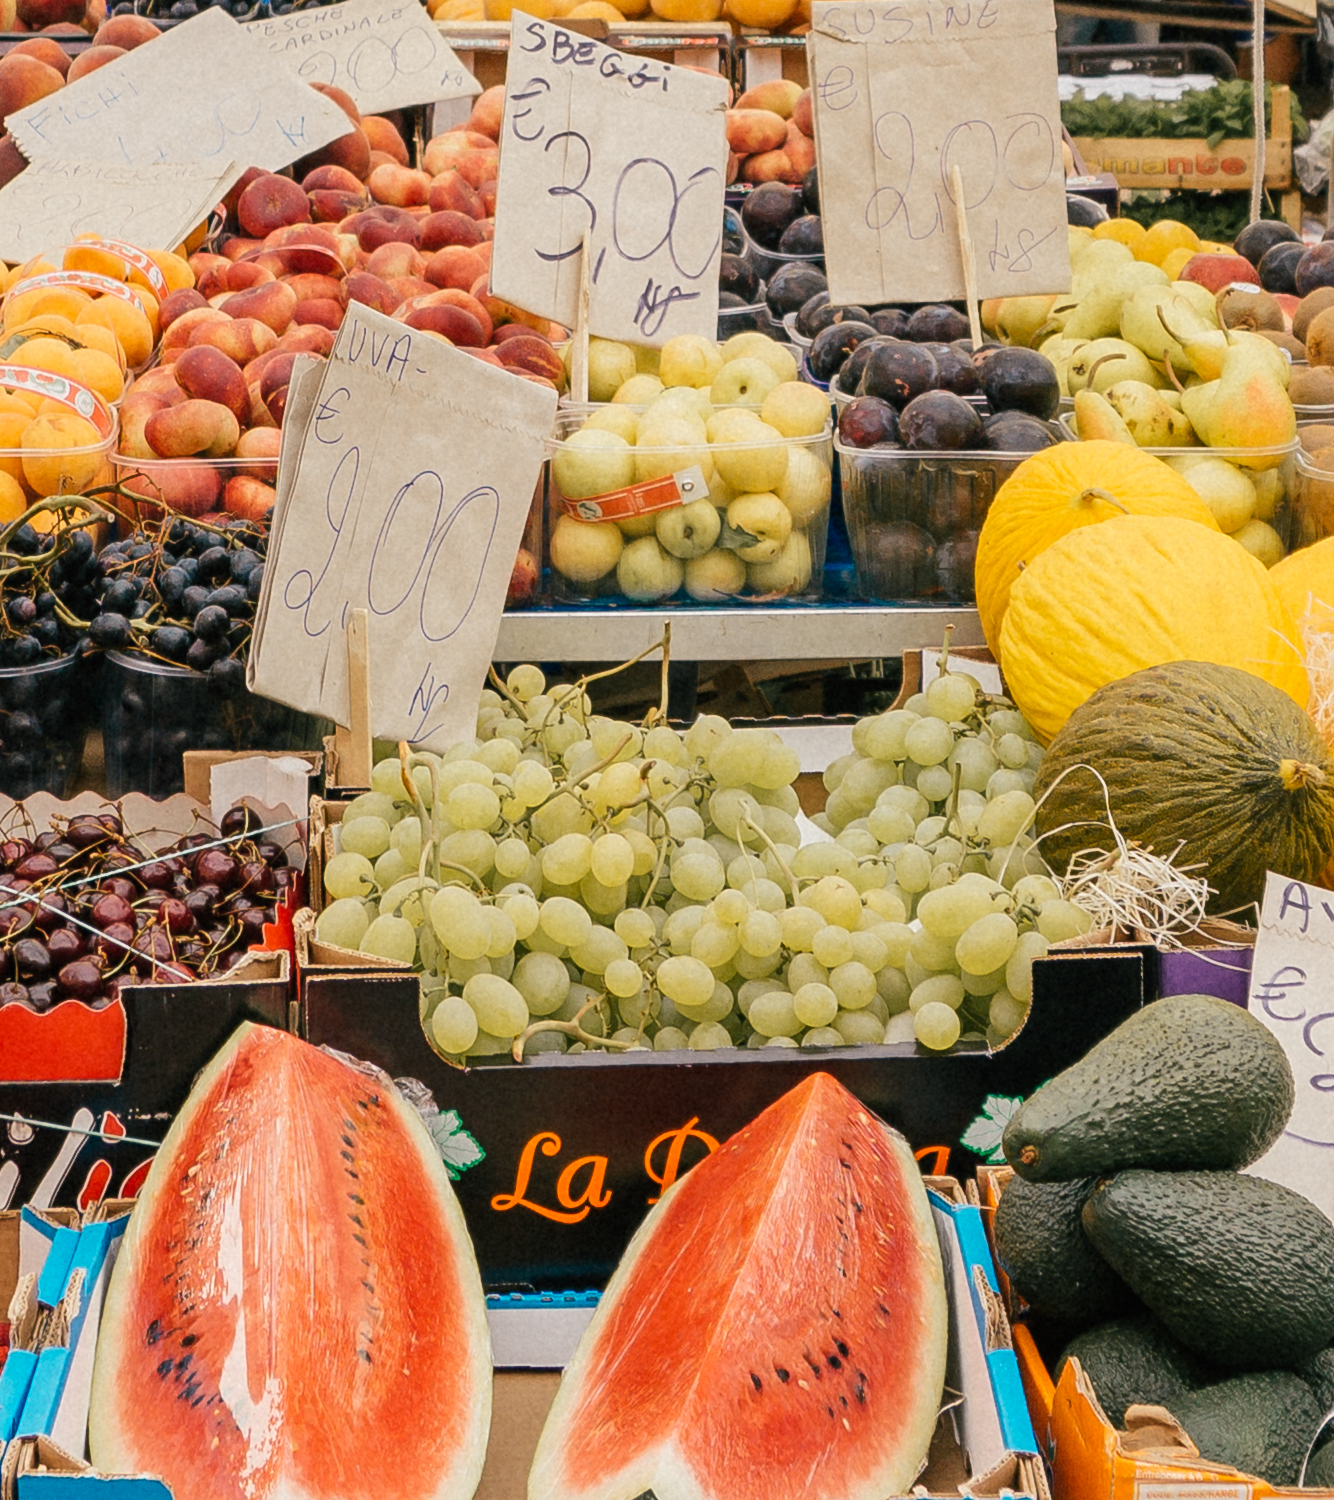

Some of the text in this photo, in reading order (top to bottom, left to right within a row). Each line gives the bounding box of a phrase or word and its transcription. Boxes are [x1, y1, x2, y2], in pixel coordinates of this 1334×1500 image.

[817, 67, 857, 108] €
[534, 131, 723, 284] 3,00
[314, 385, 351, 445] €
[284, 447, 500, 642] 2,00
[1255, 963, 1309, 1022] €
[490, 1131, 612, 1225] La
